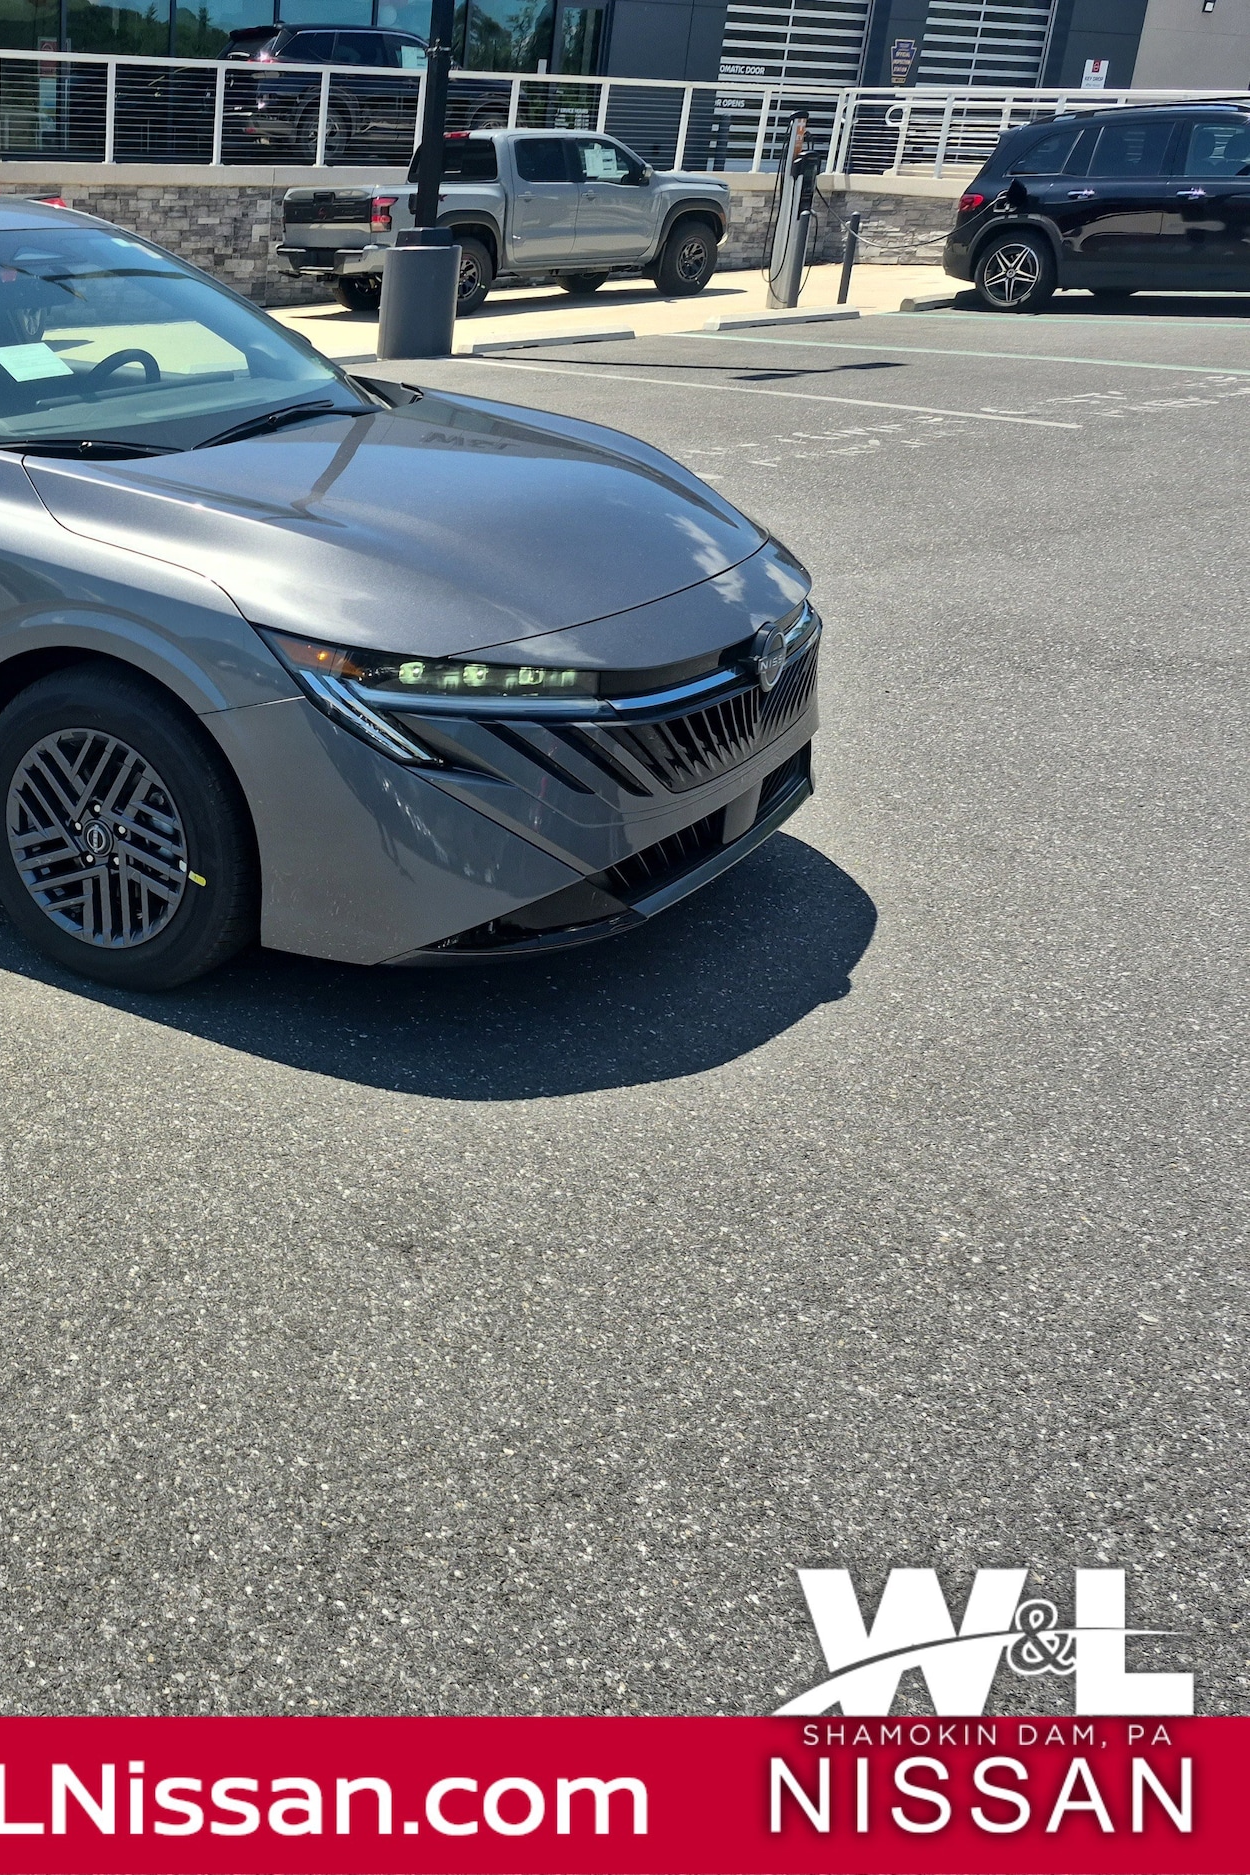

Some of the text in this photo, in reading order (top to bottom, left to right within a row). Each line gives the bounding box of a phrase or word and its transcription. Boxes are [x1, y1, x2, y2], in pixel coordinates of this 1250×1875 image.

[720, 65, 765, 75] OMATIC DOOR
[722, 99, 745, 107] OPENS
